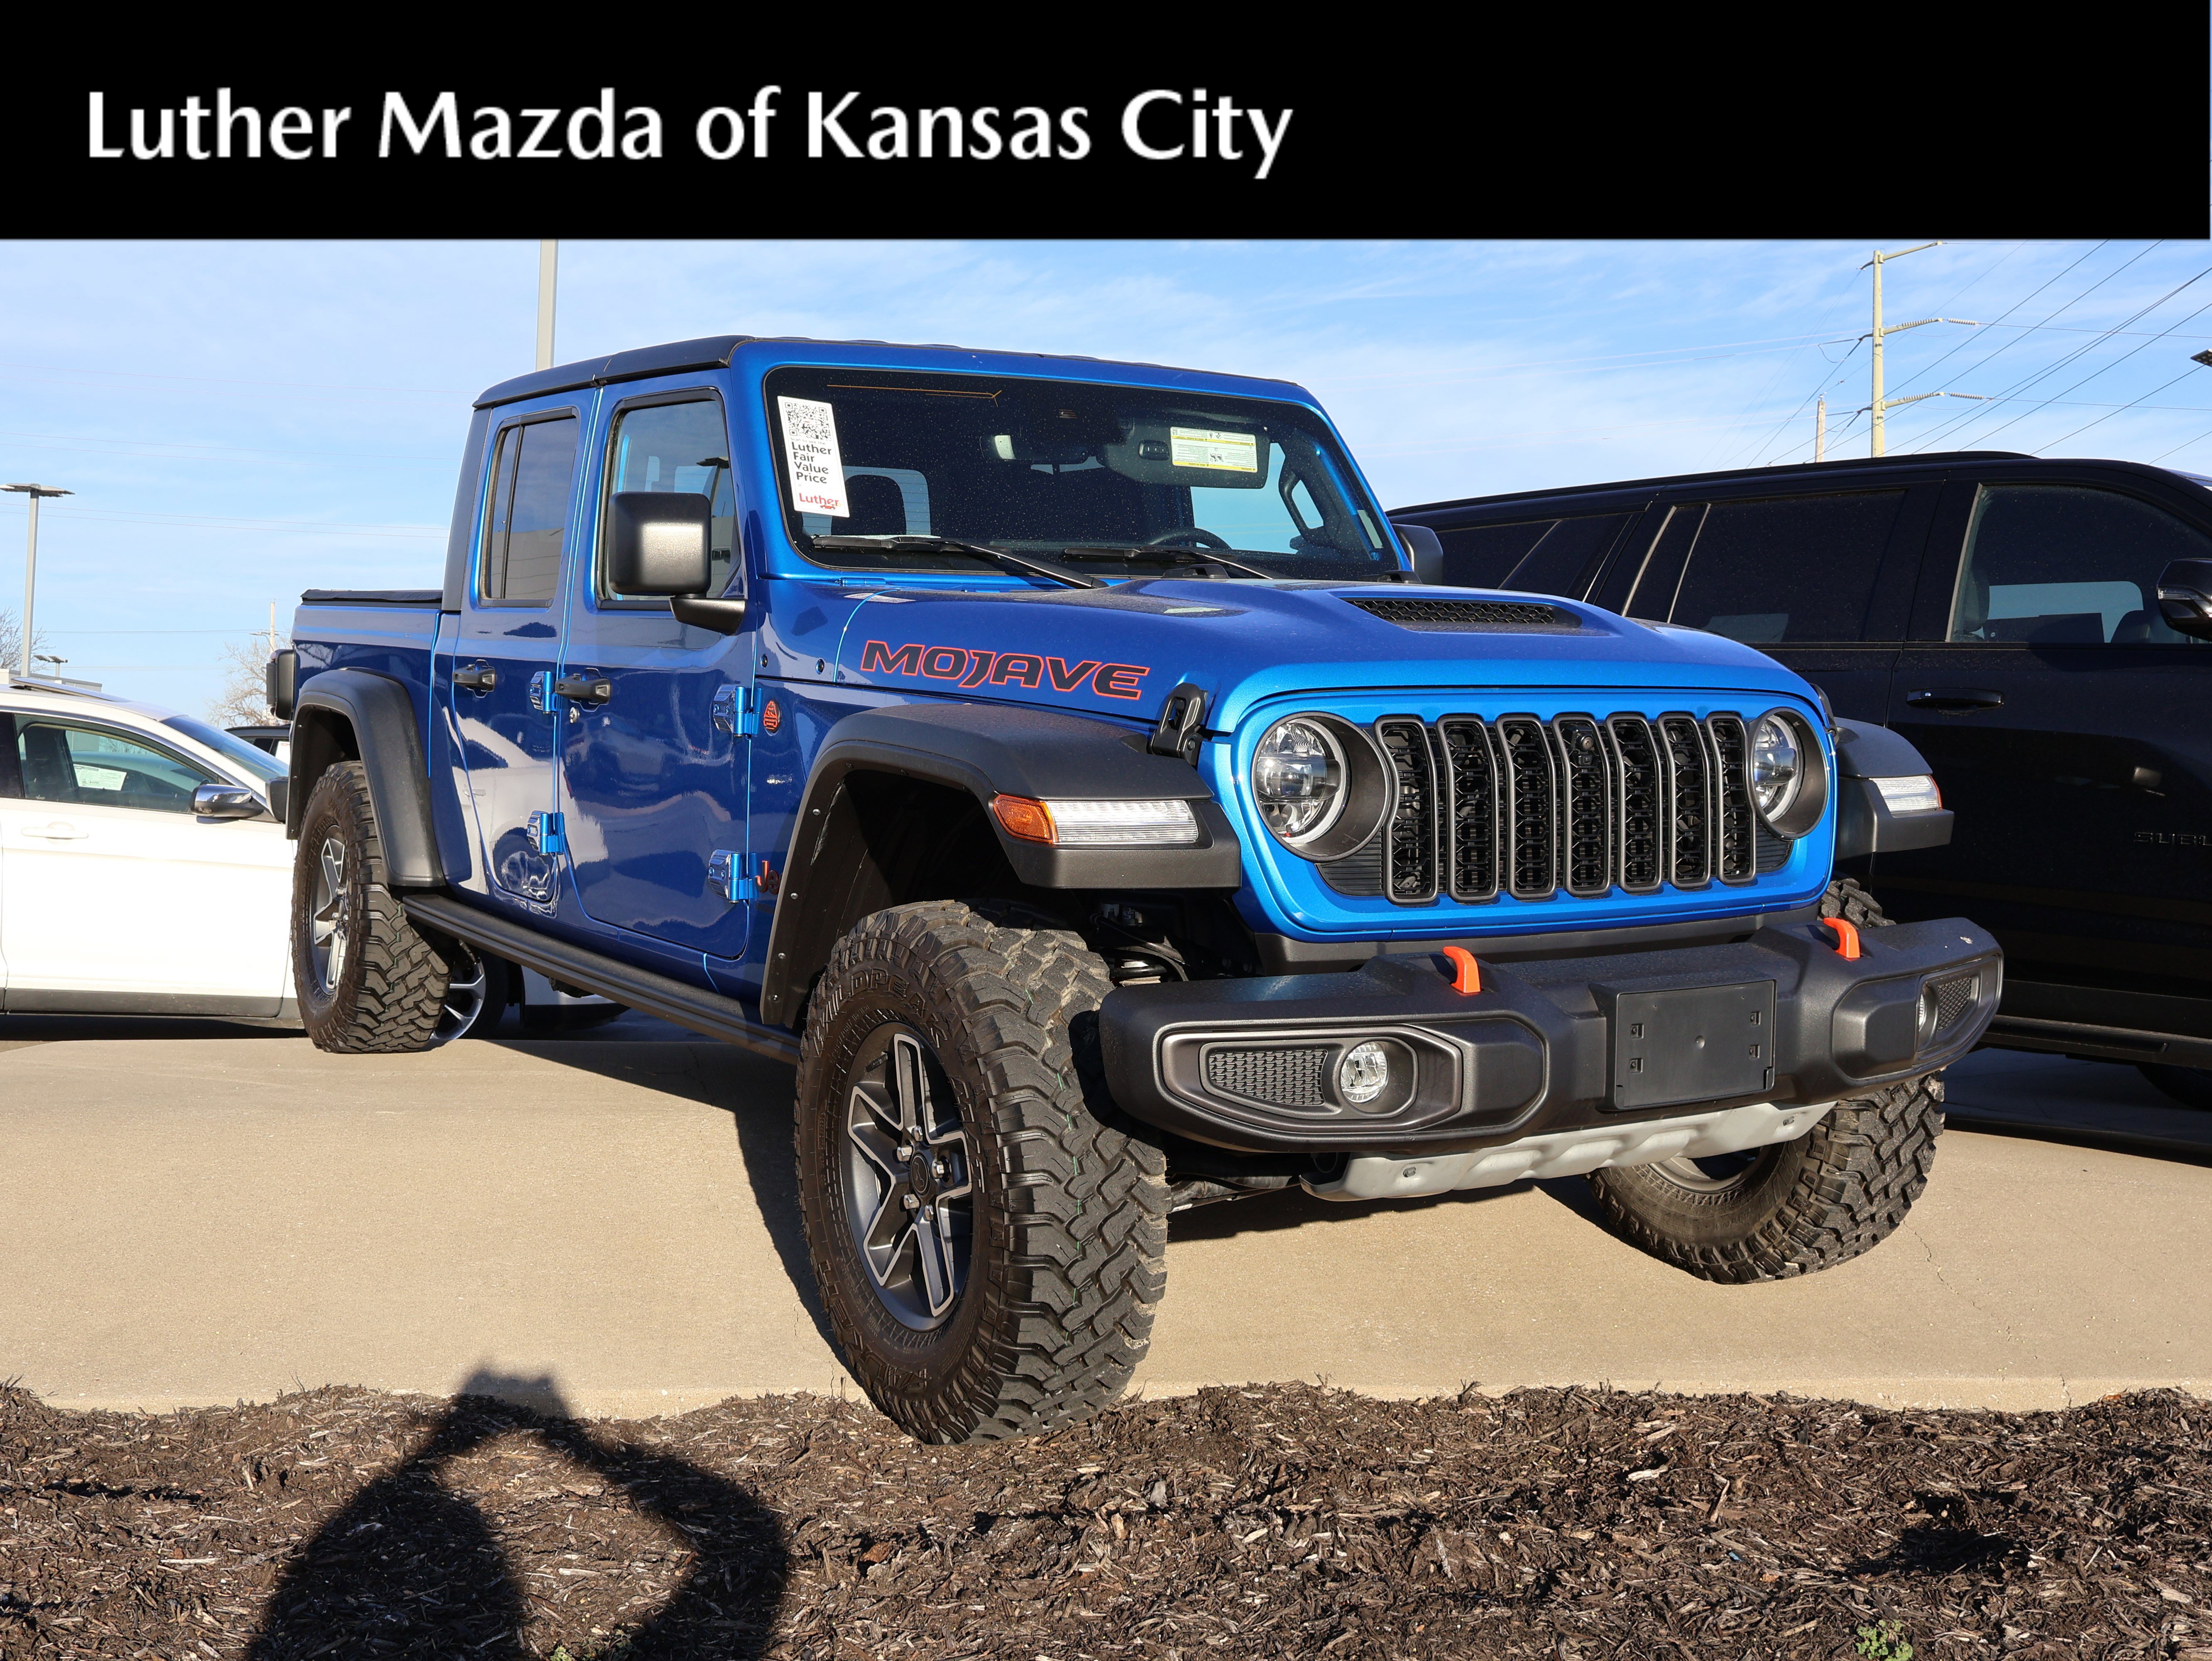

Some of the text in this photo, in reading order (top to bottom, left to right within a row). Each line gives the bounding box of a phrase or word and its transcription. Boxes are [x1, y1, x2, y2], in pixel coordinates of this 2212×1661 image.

[791, 441, 832, 455] Luther
[793, 451, 815, 462] Fair
[794, 461, 829, 474] Value
[796, 471, 827, 484] Price
[799, 492, 839, 506] Luther
[861, 640, 1150, 701] MOJAVE
[755, 860, 783, 895] Je
